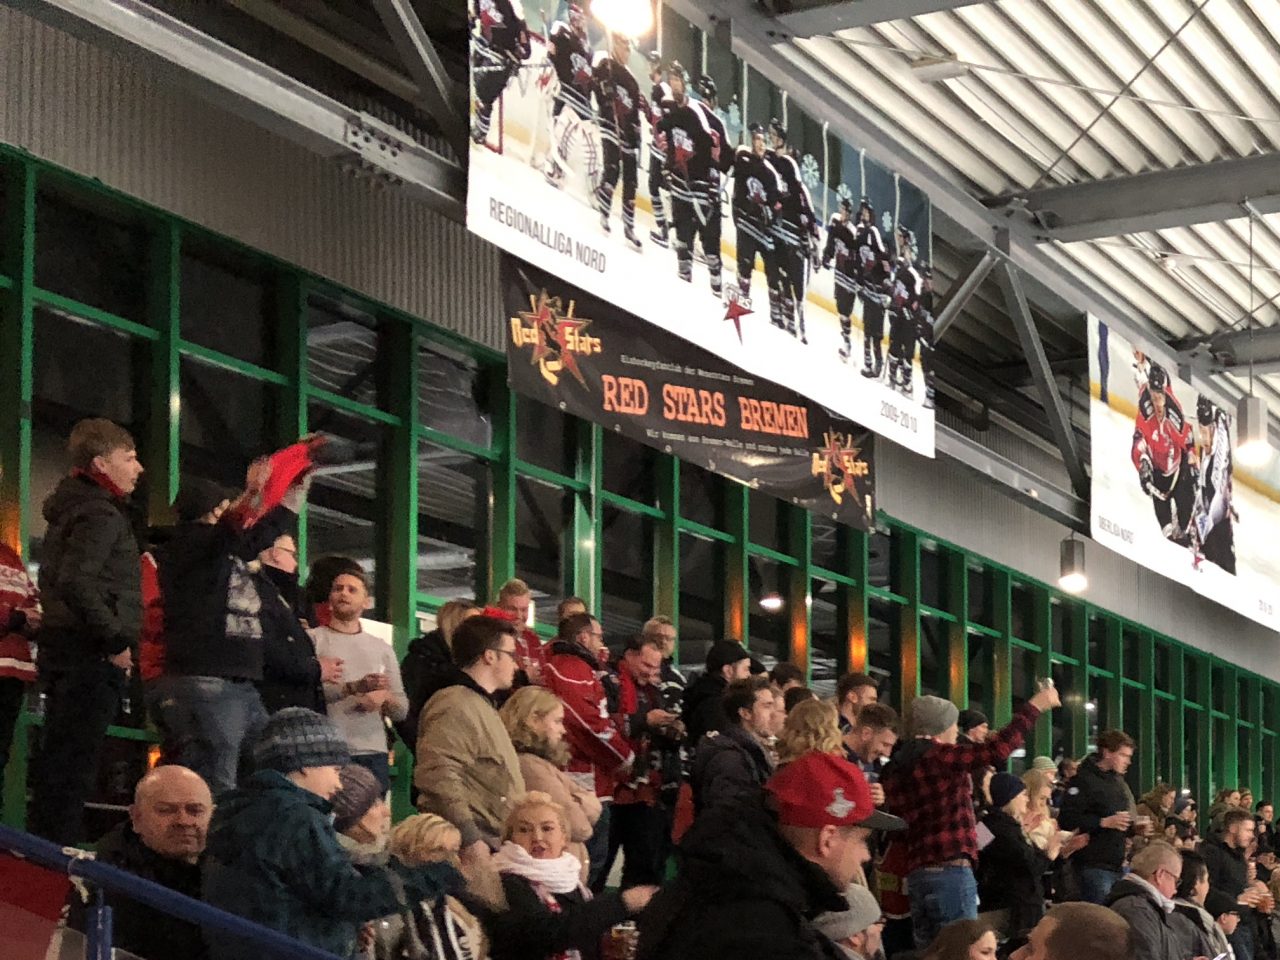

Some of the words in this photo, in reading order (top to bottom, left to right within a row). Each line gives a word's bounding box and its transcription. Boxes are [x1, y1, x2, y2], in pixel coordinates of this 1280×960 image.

[489, 197, 573, 257] REGIONALLIGA
[575, 241, 606, 273] NORD
[564, 326, 602, 355] Stars
[601, 374, 649, 415] RED
[663, 383, 725, 427] STARS
[738, 396, 809, 439] BREMEN
